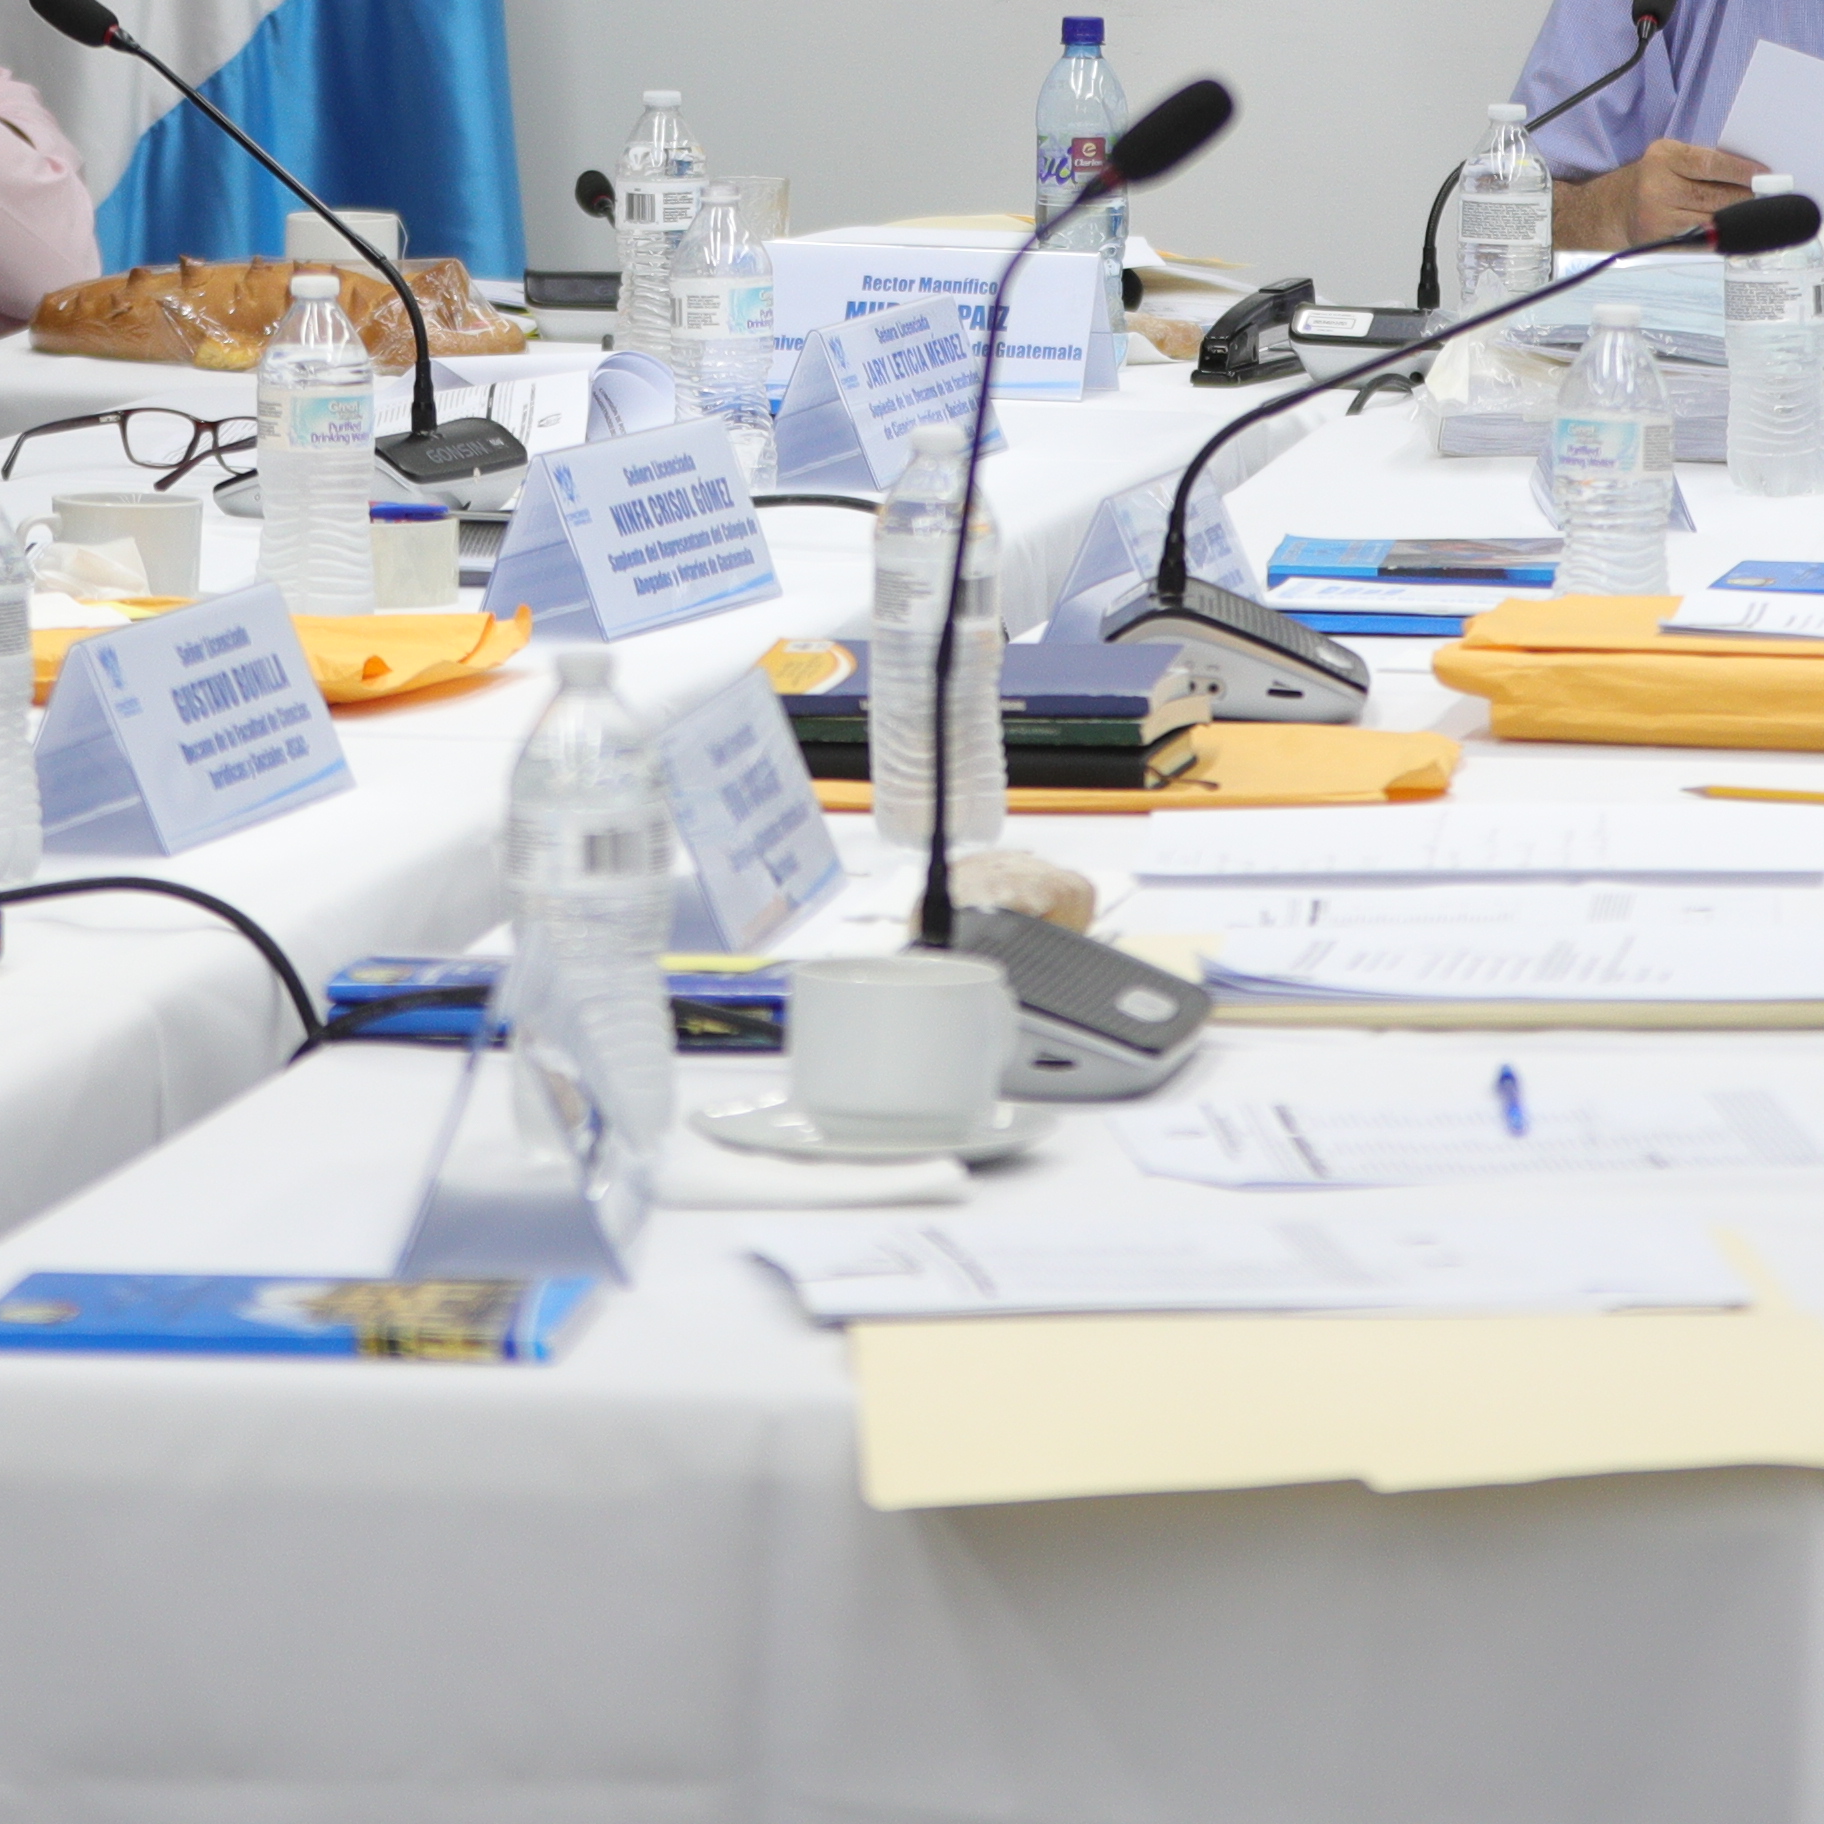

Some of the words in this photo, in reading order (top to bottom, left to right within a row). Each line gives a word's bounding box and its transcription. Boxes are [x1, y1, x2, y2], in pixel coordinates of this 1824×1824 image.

[862, 275, 914, 294] Rector
[918, 276, 999, 296] Magnífico
[862, 355, 892, 390] JARY
[888, 344, 929, 382] LETICIA
[924, 332, 968, 370] MÉNDEZ
[995, 341, 1083, 362] Guatemala
[425, 439, 490, 464] GONSIN
[623, 462, 654, 487] Señora
[650, 452, 697, 480] Licenciada
[608, 498, 656, 537] NINFA
[647, 486, 698, 528] CRISOL
[690, 476, 735, 517] GÓMEZ
[171, 670, 241, 726] GUSTAVO
[231, 652, 292, 704] BONILLA
